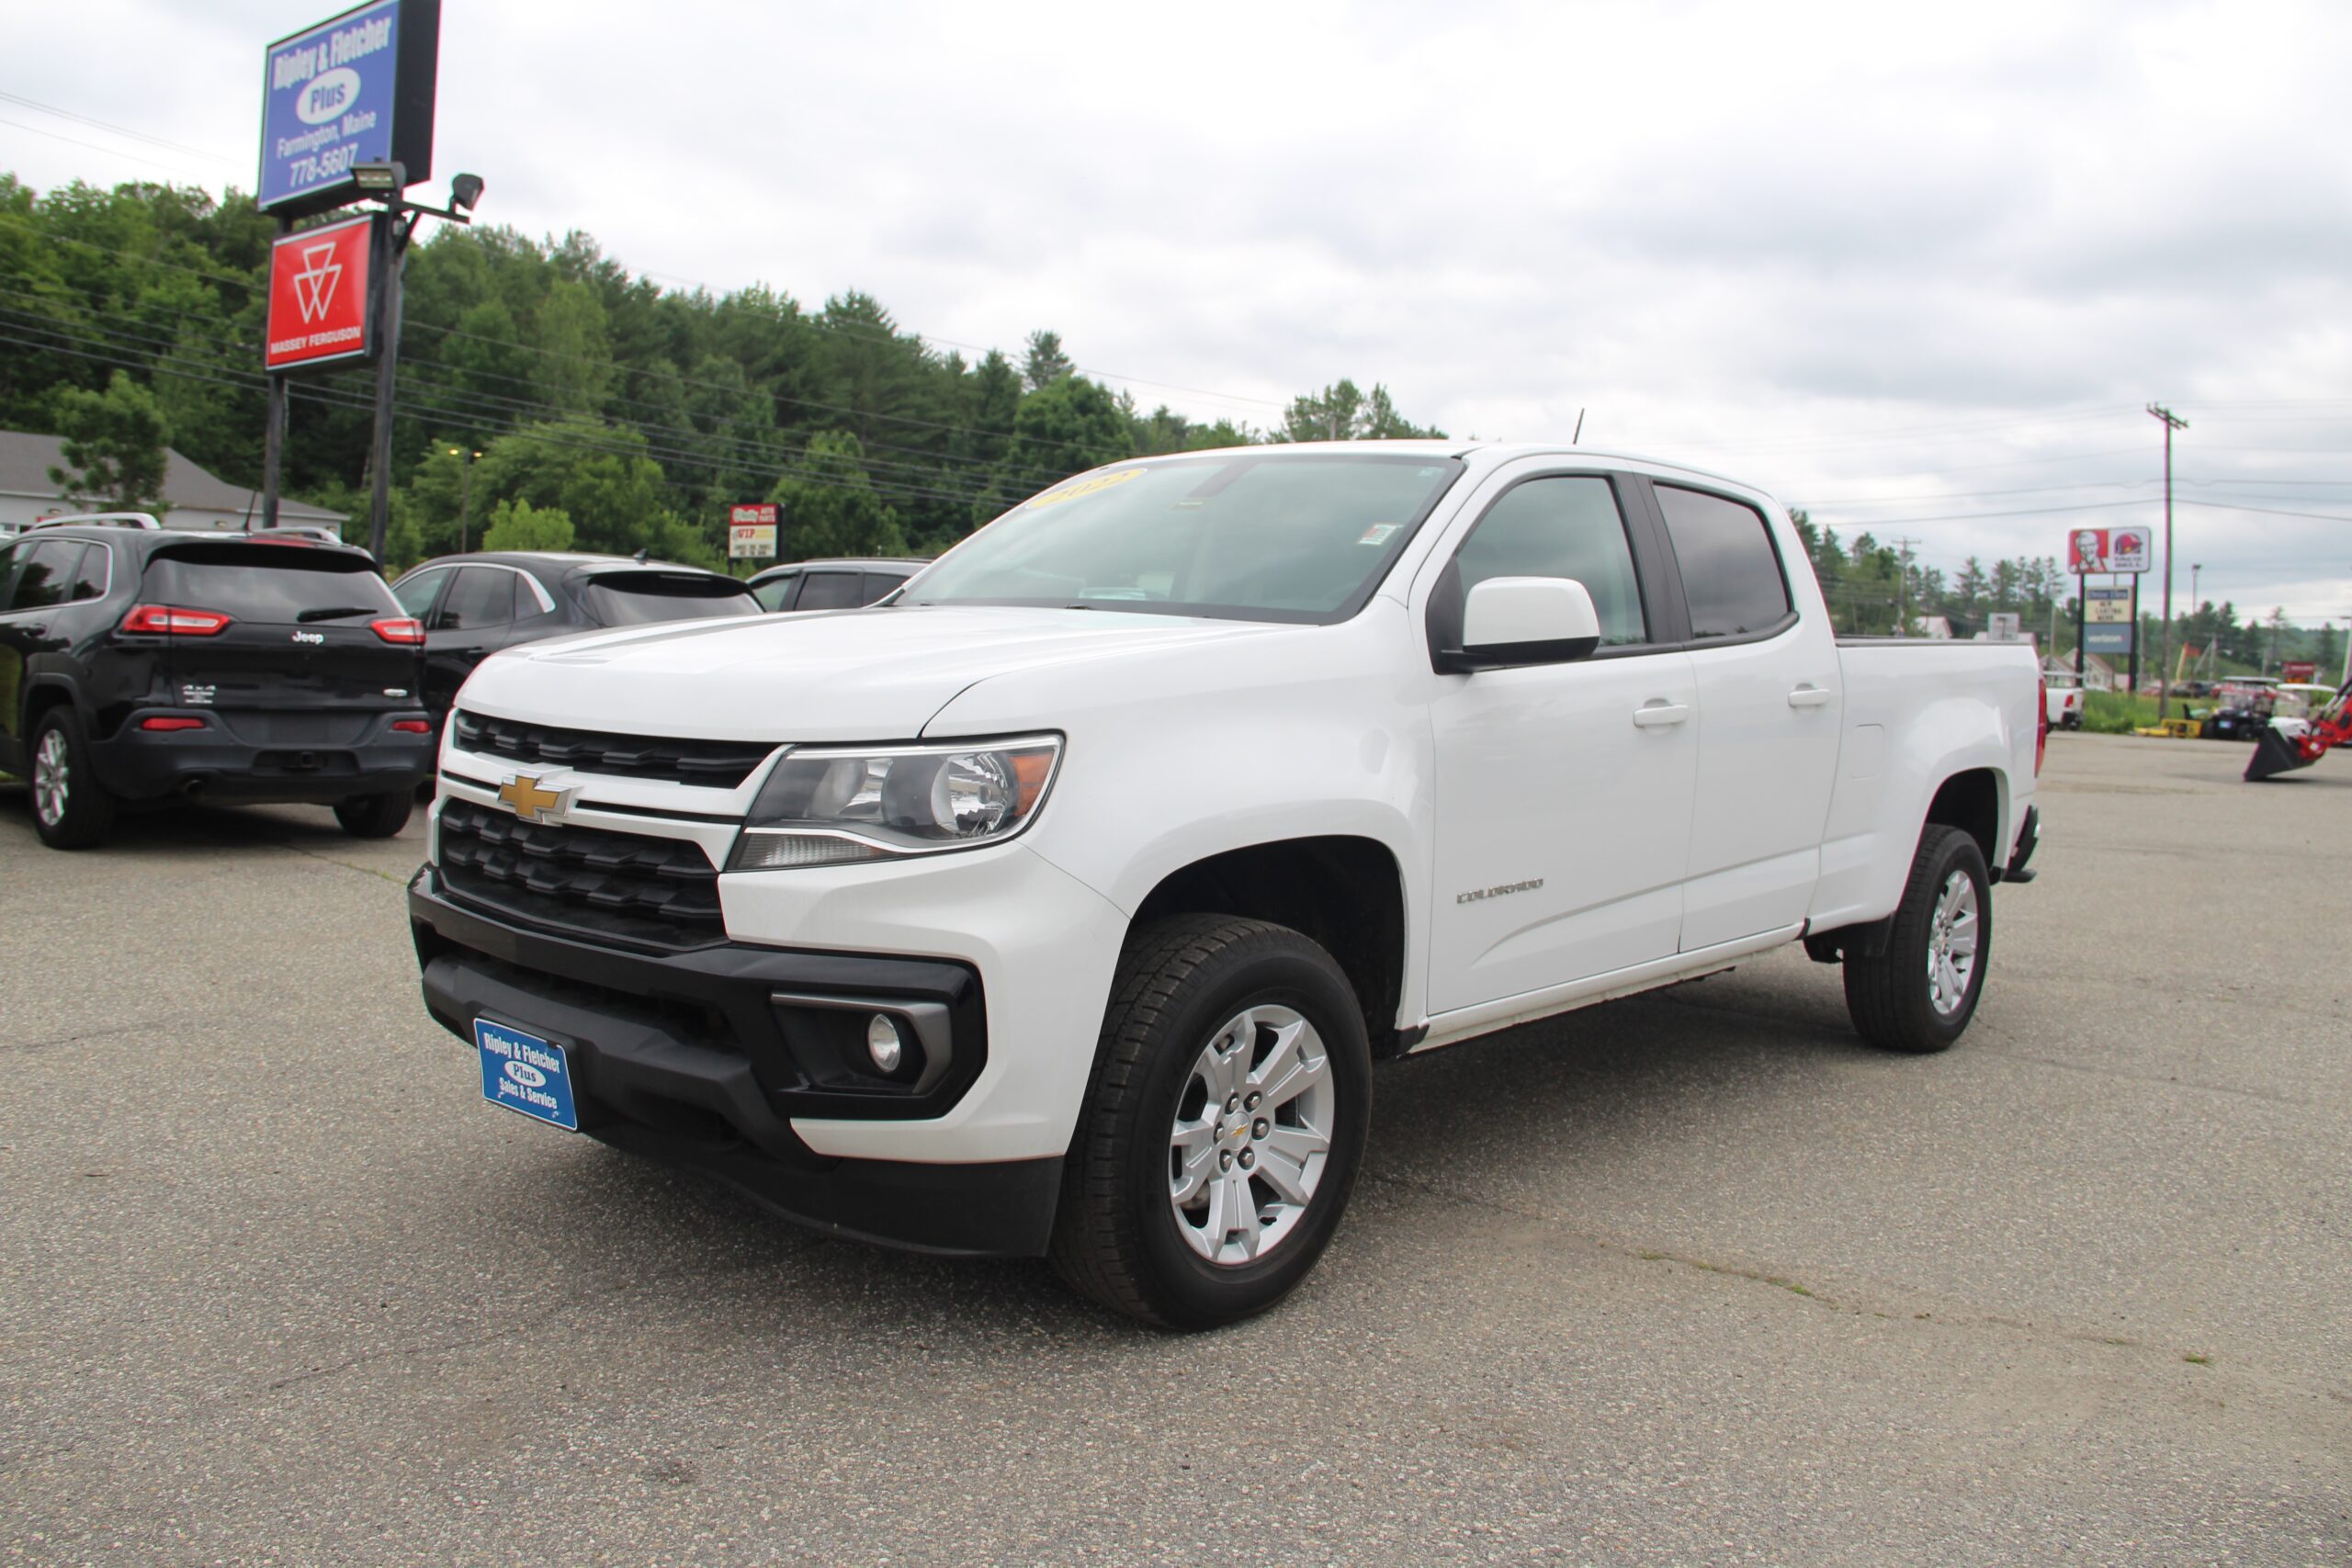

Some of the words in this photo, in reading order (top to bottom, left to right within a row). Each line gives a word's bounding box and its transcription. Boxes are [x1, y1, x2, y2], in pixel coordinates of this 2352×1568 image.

[273, 45, 318, 90] Ripley
[318, 42, 329, 73] &
[330, 17, 392, 68] Fletcher
[310, 82, 347, 115] Plus
[277, 125, 341, 160] Farmington,
[342, 110, 378, 138] Maine
[289, 142, 359, 188] 778-5607
[270, 336, 308, 355] MASSEY
[309, 326, 362, 347] FERGUSON
[738, 528, 755, 539] VIP
[292, 630, 323, 645] Jeep
[1456, 878, 1544, 905] COLORADO
[483, 1032, 512, 1059] Ripley
[514, 1042, 522, 1061] &
[522, 1043, 560, 1074] Fletcher
[512, 1064, 537, 1083] Plus
[499, 1077, 520, 1097] Sales
[520, 1085, 526, 1100] &
[526, 1087, 558, 1110] Service
